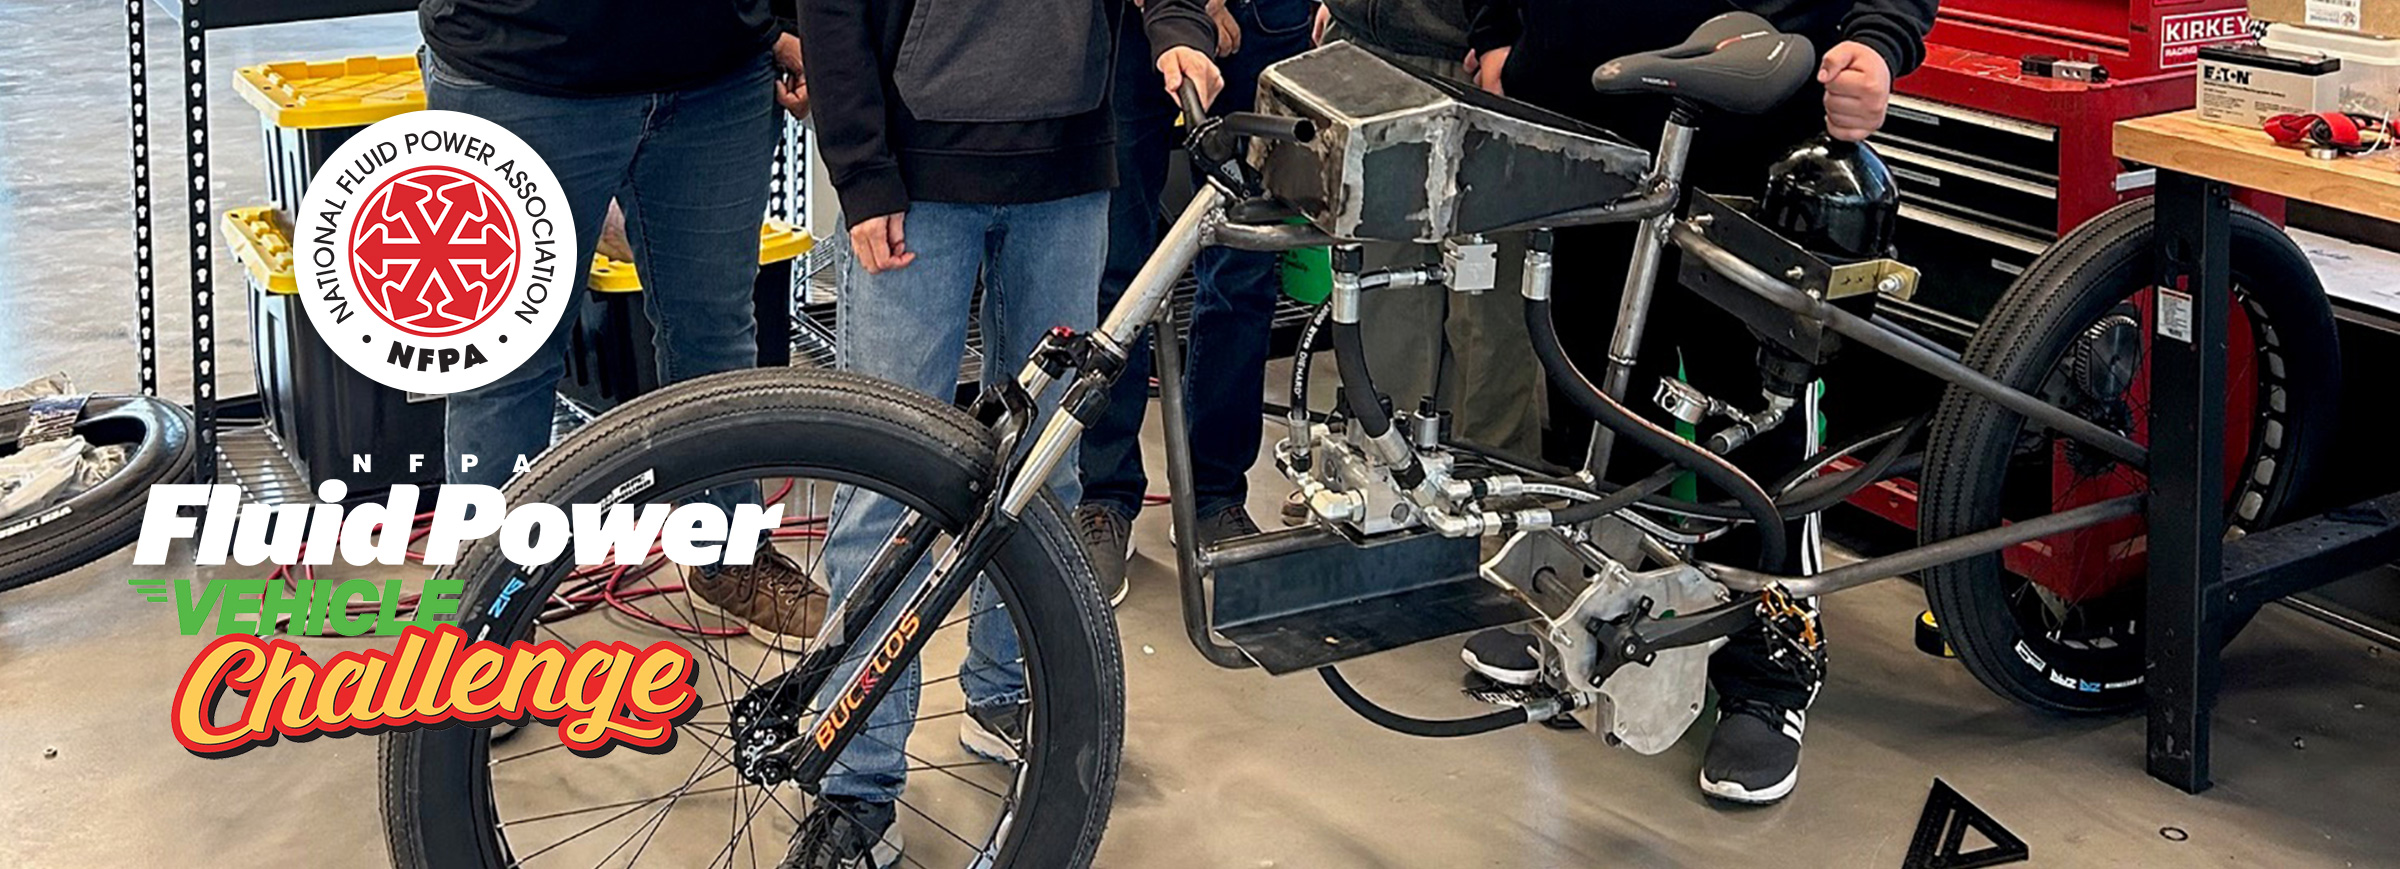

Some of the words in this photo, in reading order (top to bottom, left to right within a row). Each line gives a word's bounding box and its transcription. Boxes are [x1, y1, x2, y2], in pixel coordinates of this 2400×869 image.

[2166, 15, 2249, 42] KIRKEY
[2165, 46, 2198, 57] RACING
[2203, 65, 2250, 85] EATON
